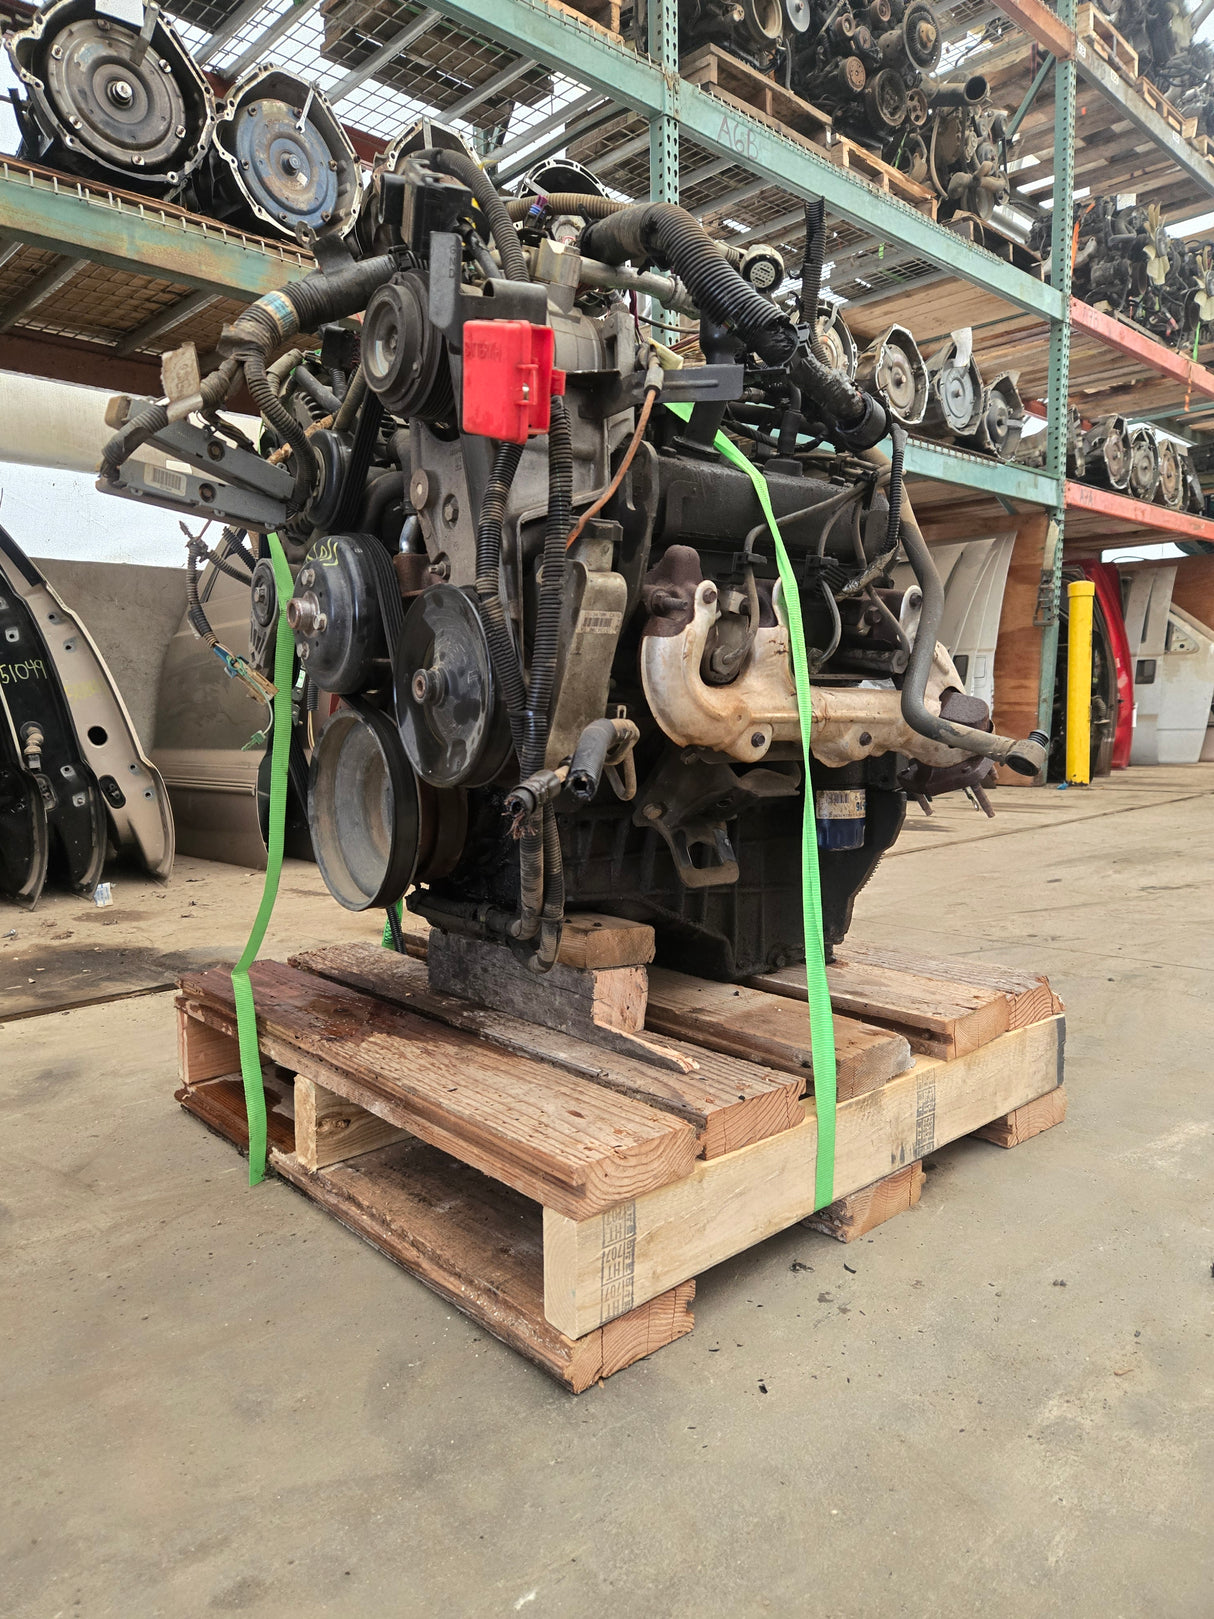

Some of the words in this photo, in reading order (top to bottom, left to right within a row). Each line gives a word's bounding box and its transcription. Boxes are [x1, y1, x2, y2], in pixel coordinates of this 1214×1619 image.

[717, 116, 759, 160] A6B
[0, 660, 47, 684] 51049
[605, 1244, 623, 1263] 707
[606, 1261, 621, 1281] HT
[604, 1282, 621, 1302] 707
